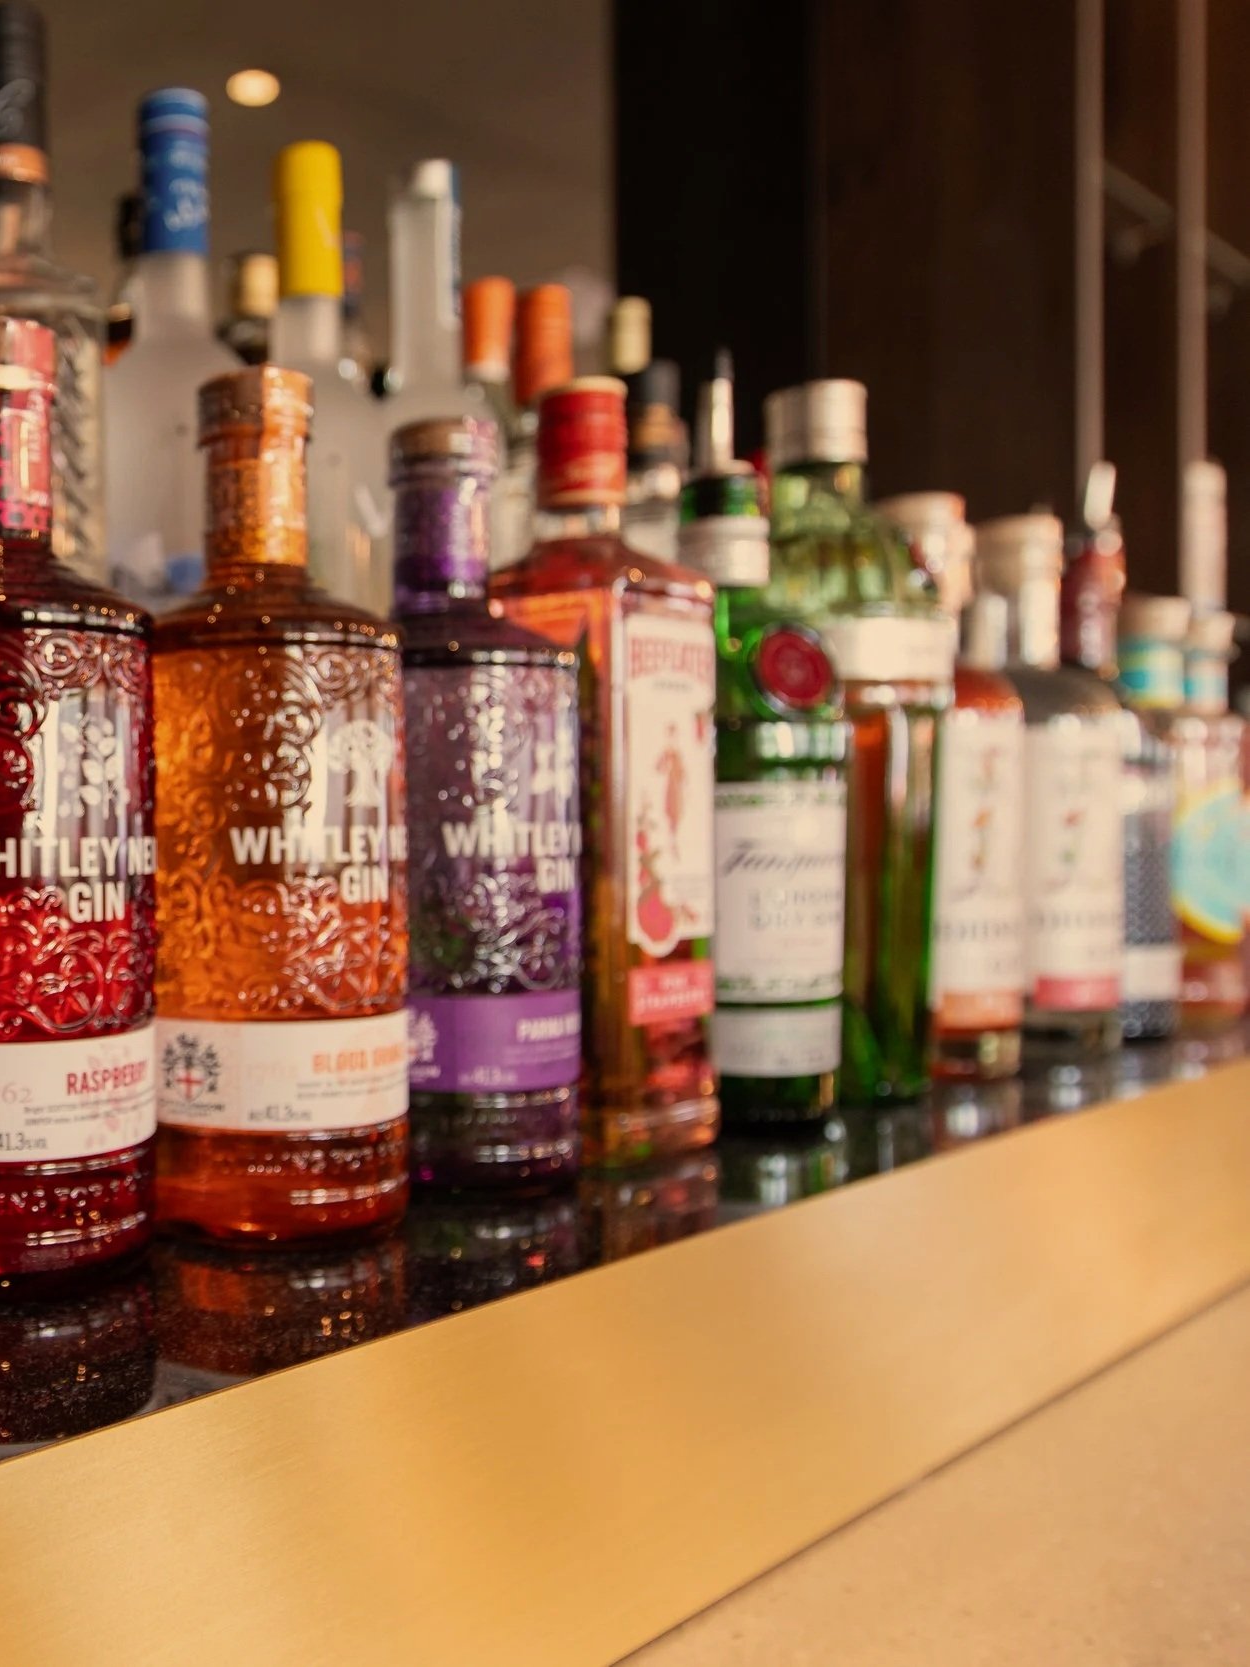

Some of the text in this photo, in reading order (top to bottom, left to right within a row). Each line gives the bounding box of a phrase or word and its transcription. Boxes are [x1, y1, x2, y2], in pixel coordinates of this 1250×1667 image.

[229, 825, 383, 865] WHITLEY
[339, 866, 390, 904] GIN
[536, 857, 577, 893] GIN
[69, 881, 126, 923] GIN
